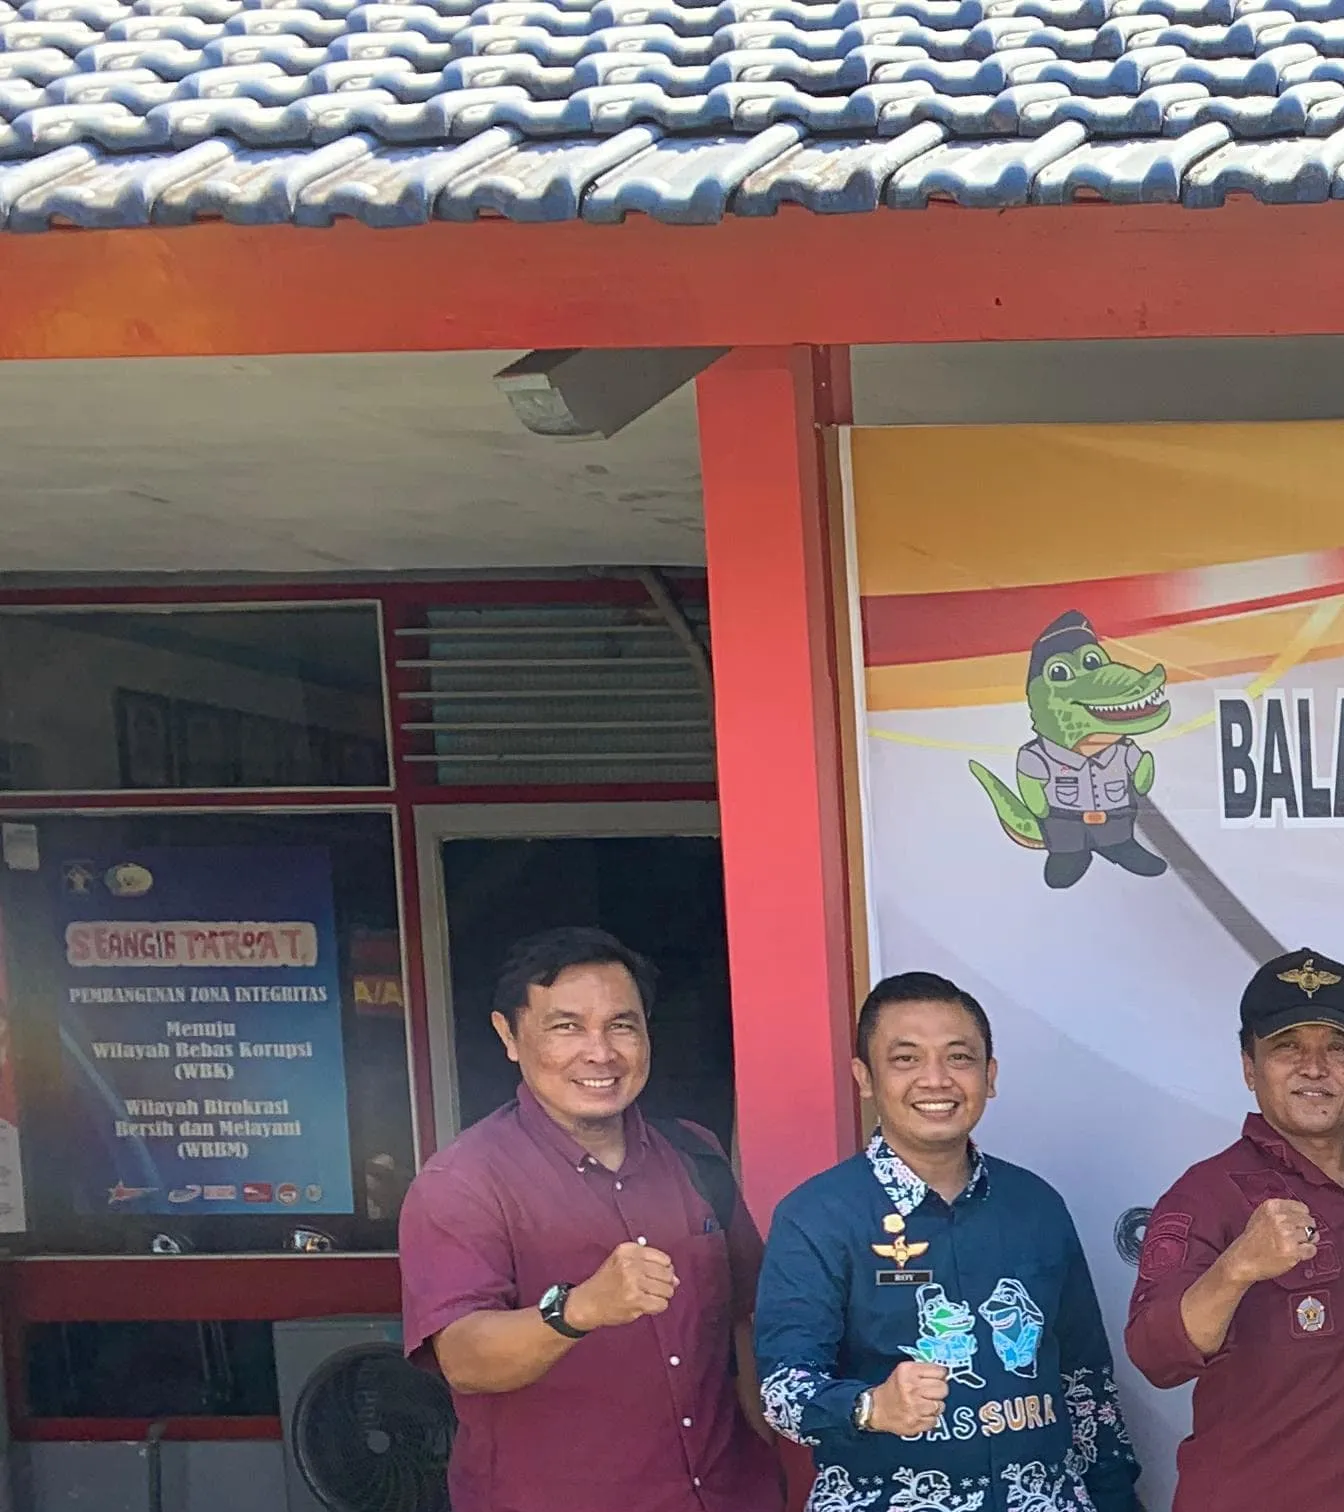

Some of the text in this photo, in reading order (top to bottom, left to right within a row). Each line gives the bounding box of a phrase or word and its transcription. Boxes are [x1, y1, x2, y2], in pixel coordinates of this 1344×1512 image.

[166, 1021, 236, 1038] Menuju
[92, 1041, 313, 1060] Wilayah Bebas Korupsi
[174, 1063, 234, 1080] (WBK)
[125, 1099, 289, 1117] Wilayah Birokrasi
[115, 1119, 302, 1138] Bersih dan Melayani
